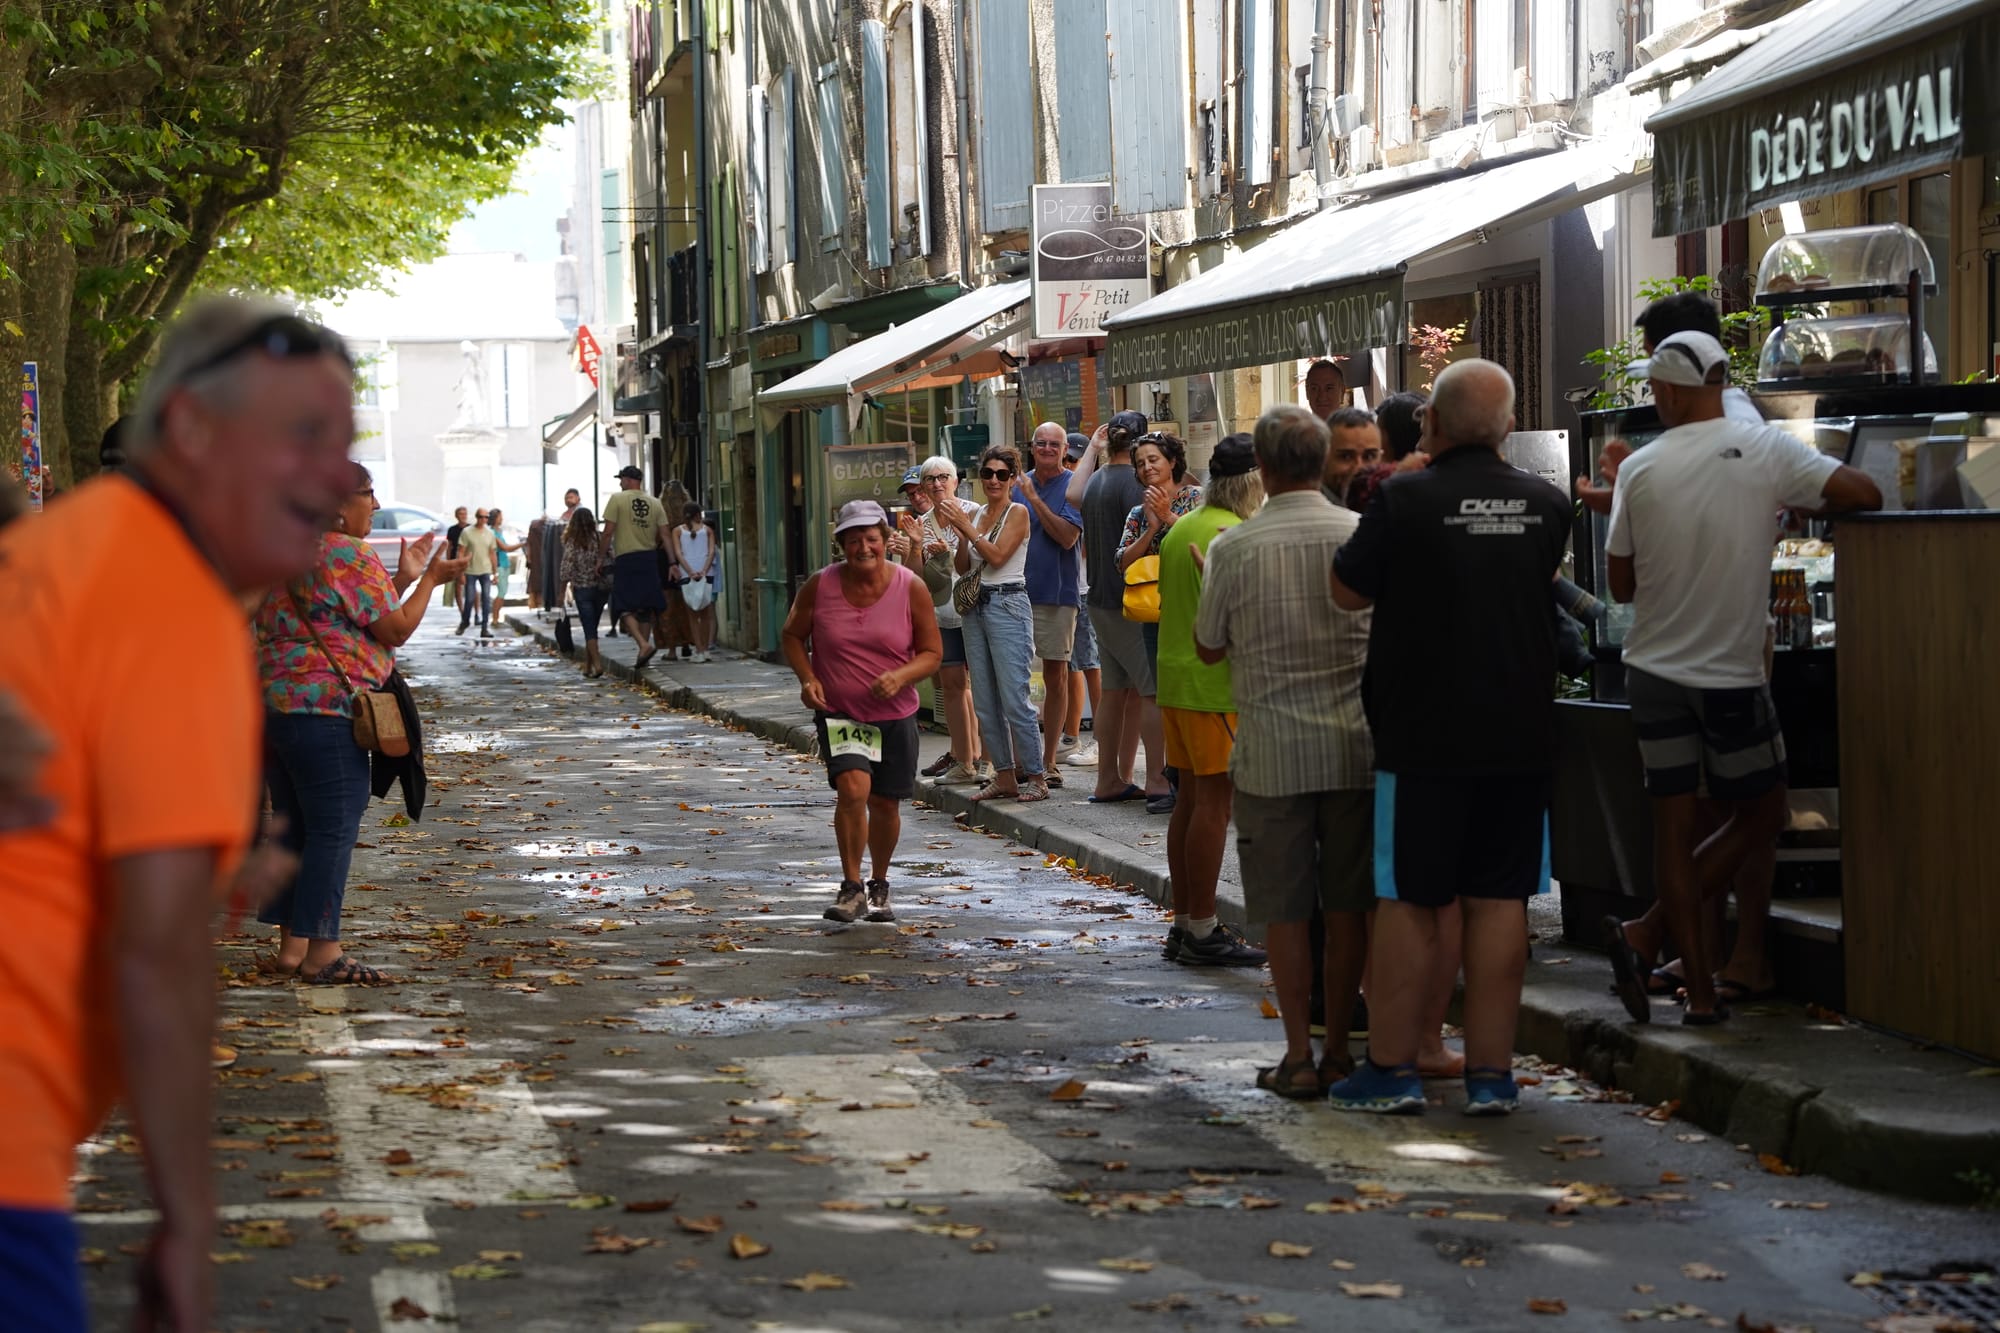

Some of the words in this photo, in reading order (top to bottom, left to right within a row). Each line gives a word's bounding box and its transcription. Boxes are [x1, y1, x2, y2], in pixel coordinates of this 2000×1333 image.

[1750, 100, 1825, 192] DÉDÉ
[1830, 92, 1877, 169] DU
[1885, 67, 1961, 151] VAL
[1093, 255, 1103, 263] 06
[1106, 255, 1114, 263] 47
[1080, 281, 1093, 292] Le
[1093, 288, 1130, 305] Petit
[1111, 332, 1168, 379] BOUCHERIE
[1173, 318, 1250, 370] CHARCUTERIE
[1256, 304, 1319, 356] MAISON
[832, 459, 909, 481] GLACES
[872, 482, 883, 497] 6
[837, 726, 874, 748] 143
